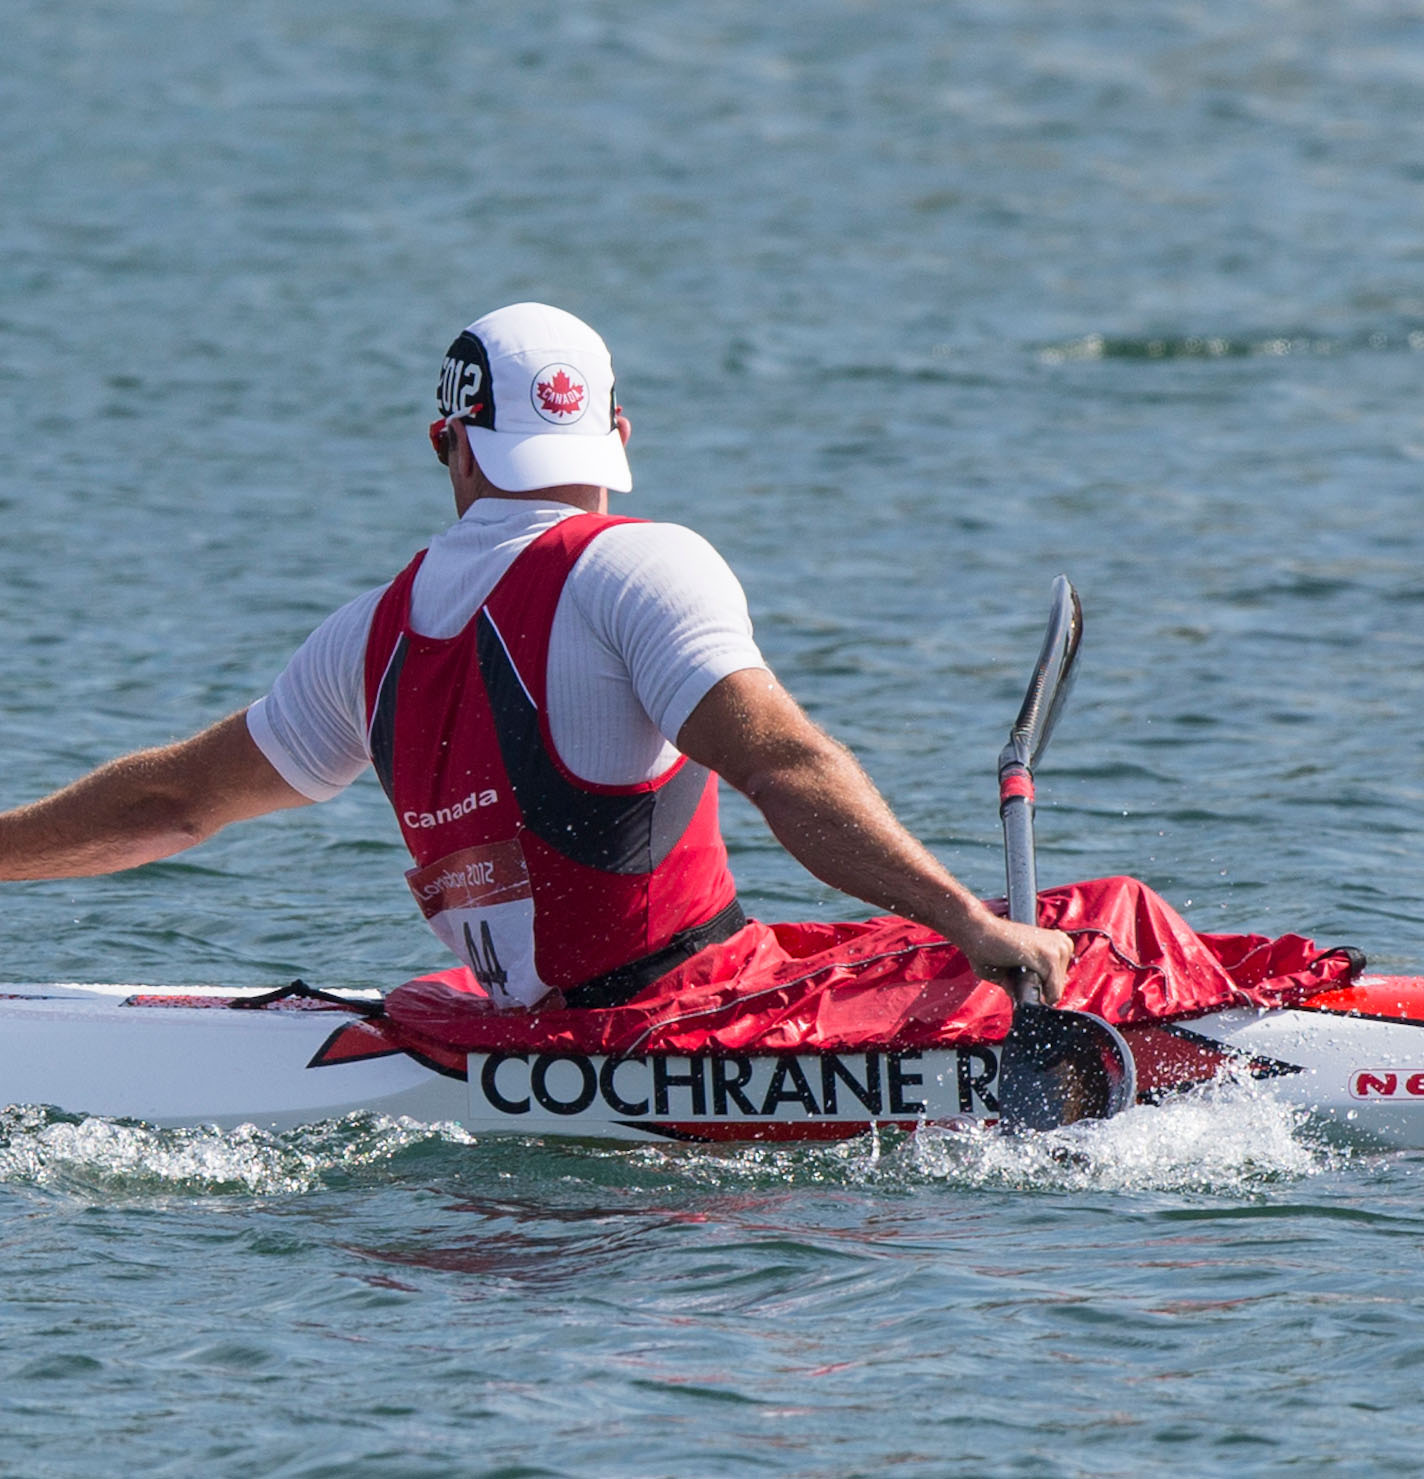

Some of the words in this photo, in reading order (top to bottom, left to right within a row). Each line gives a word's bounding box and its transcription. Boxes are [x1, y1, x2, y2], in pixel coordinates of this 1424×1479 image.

[541, 386, 582, 405] CANADA
[403, 788, 499, 829] Canada
[465, 860, 495, 887] 2012
[463, 919, 508, 996] 44
[481, 1051, 926, 1115] COCHRANE
